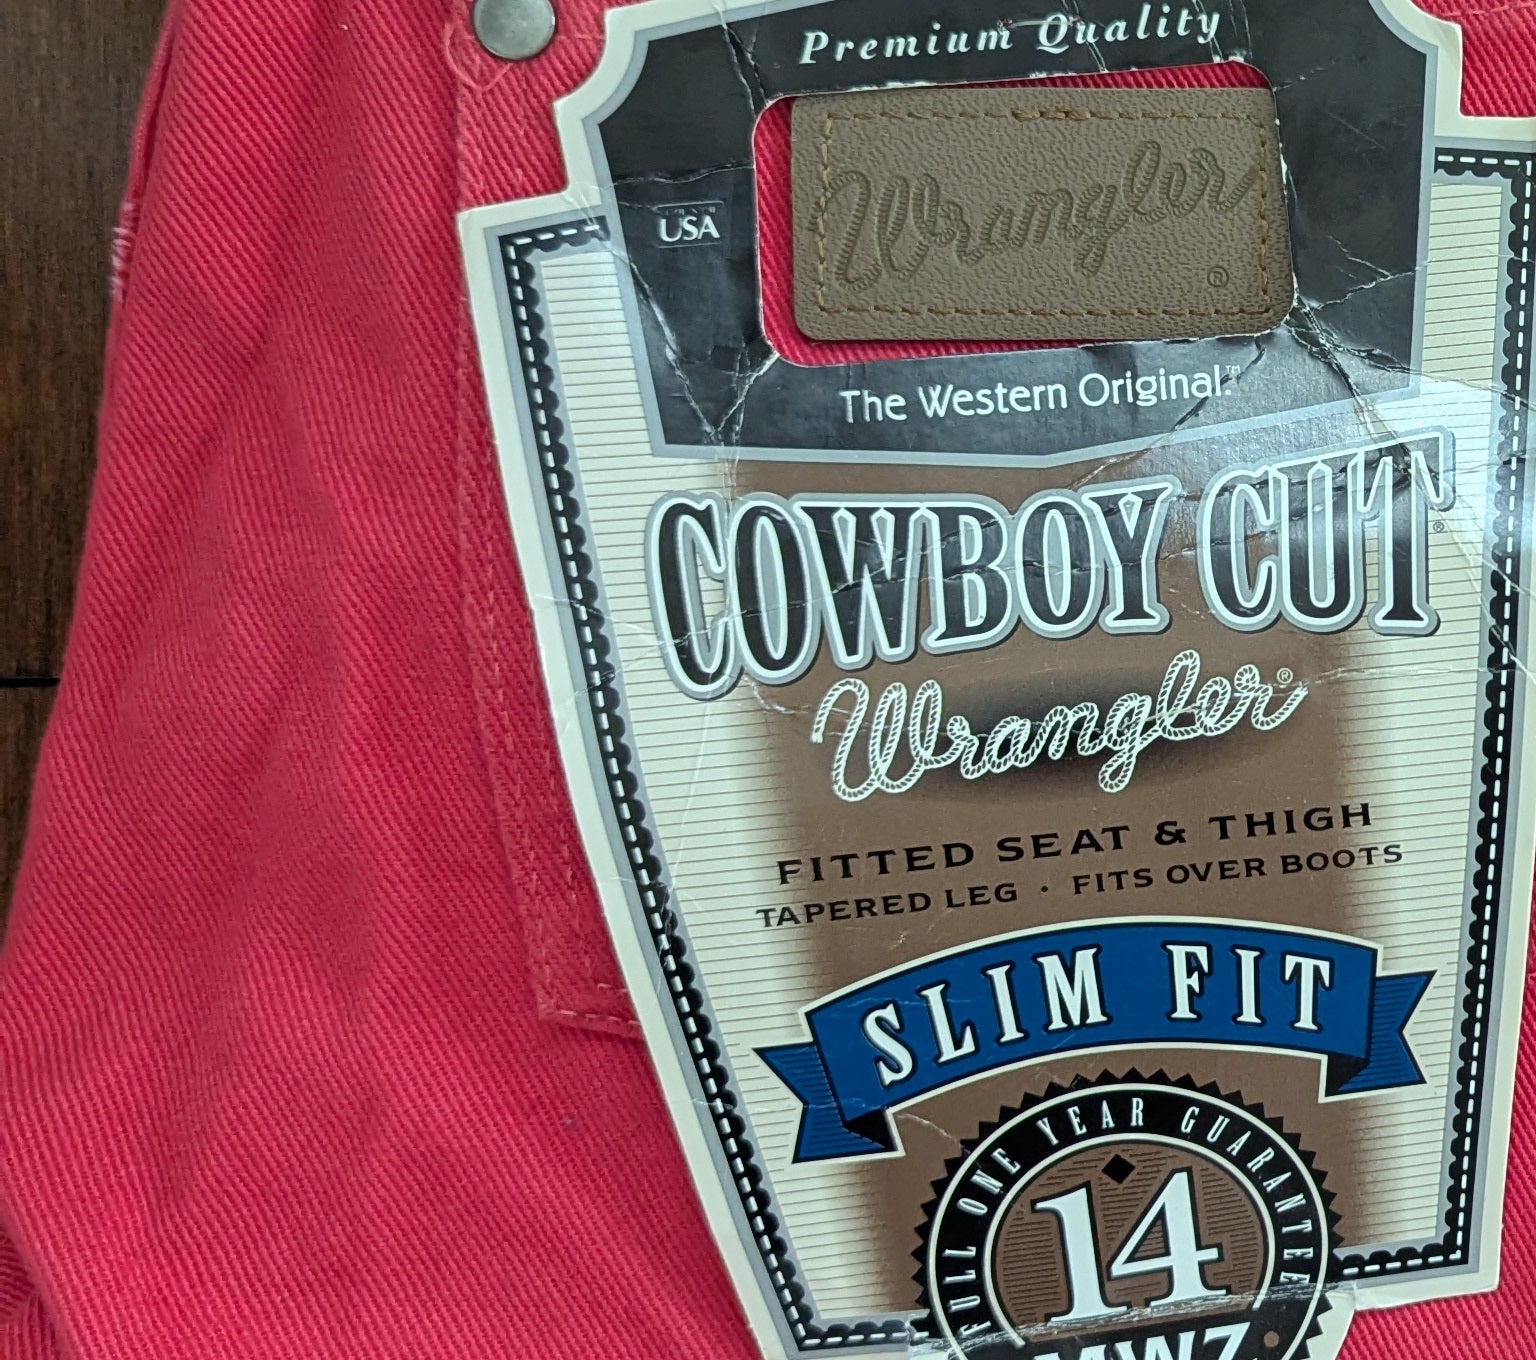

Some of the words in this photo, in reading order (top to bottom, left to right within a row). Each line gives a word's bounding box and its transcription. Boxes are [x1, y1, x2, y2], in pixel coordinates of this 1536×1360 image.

[800, 22, 1013, 65] Premium
[1037, 3, 1221, 52] Quality
[660, 214, 721, 242] USA
[840, 389, 906, 423] The
[917, 382, 1068, 420] Western
[652, 478, 1179, 698] COWBOY
[755, 891, 932, 929] TAPERED
[945, 882, 1020, 908] LEG
[1071, 866, 1154, 896] FITS
[1166, 857, 1266, 885] OVER
[1280, 843, 1404, 874] BOOTS
[776, 841, 975, 886] FITTED
[996, 825, 1131, 864] SEAT
[1154, 819, 1187, 846] &
[1208, 802, 1375, 841] THIGH
[861, 946, 1110, 1088] SLIM
[1165, 943, 1332, 1033] FIT
[1036, 1096, 1144, 1146] YEAR
[956, 1147, 1022, 1217] ONE
[1180, 1105, 1314, 1284] GUARANTEE
[1033, 1169, 1224, 1324] 14
[942, 1245, 992, 1339] FULL
